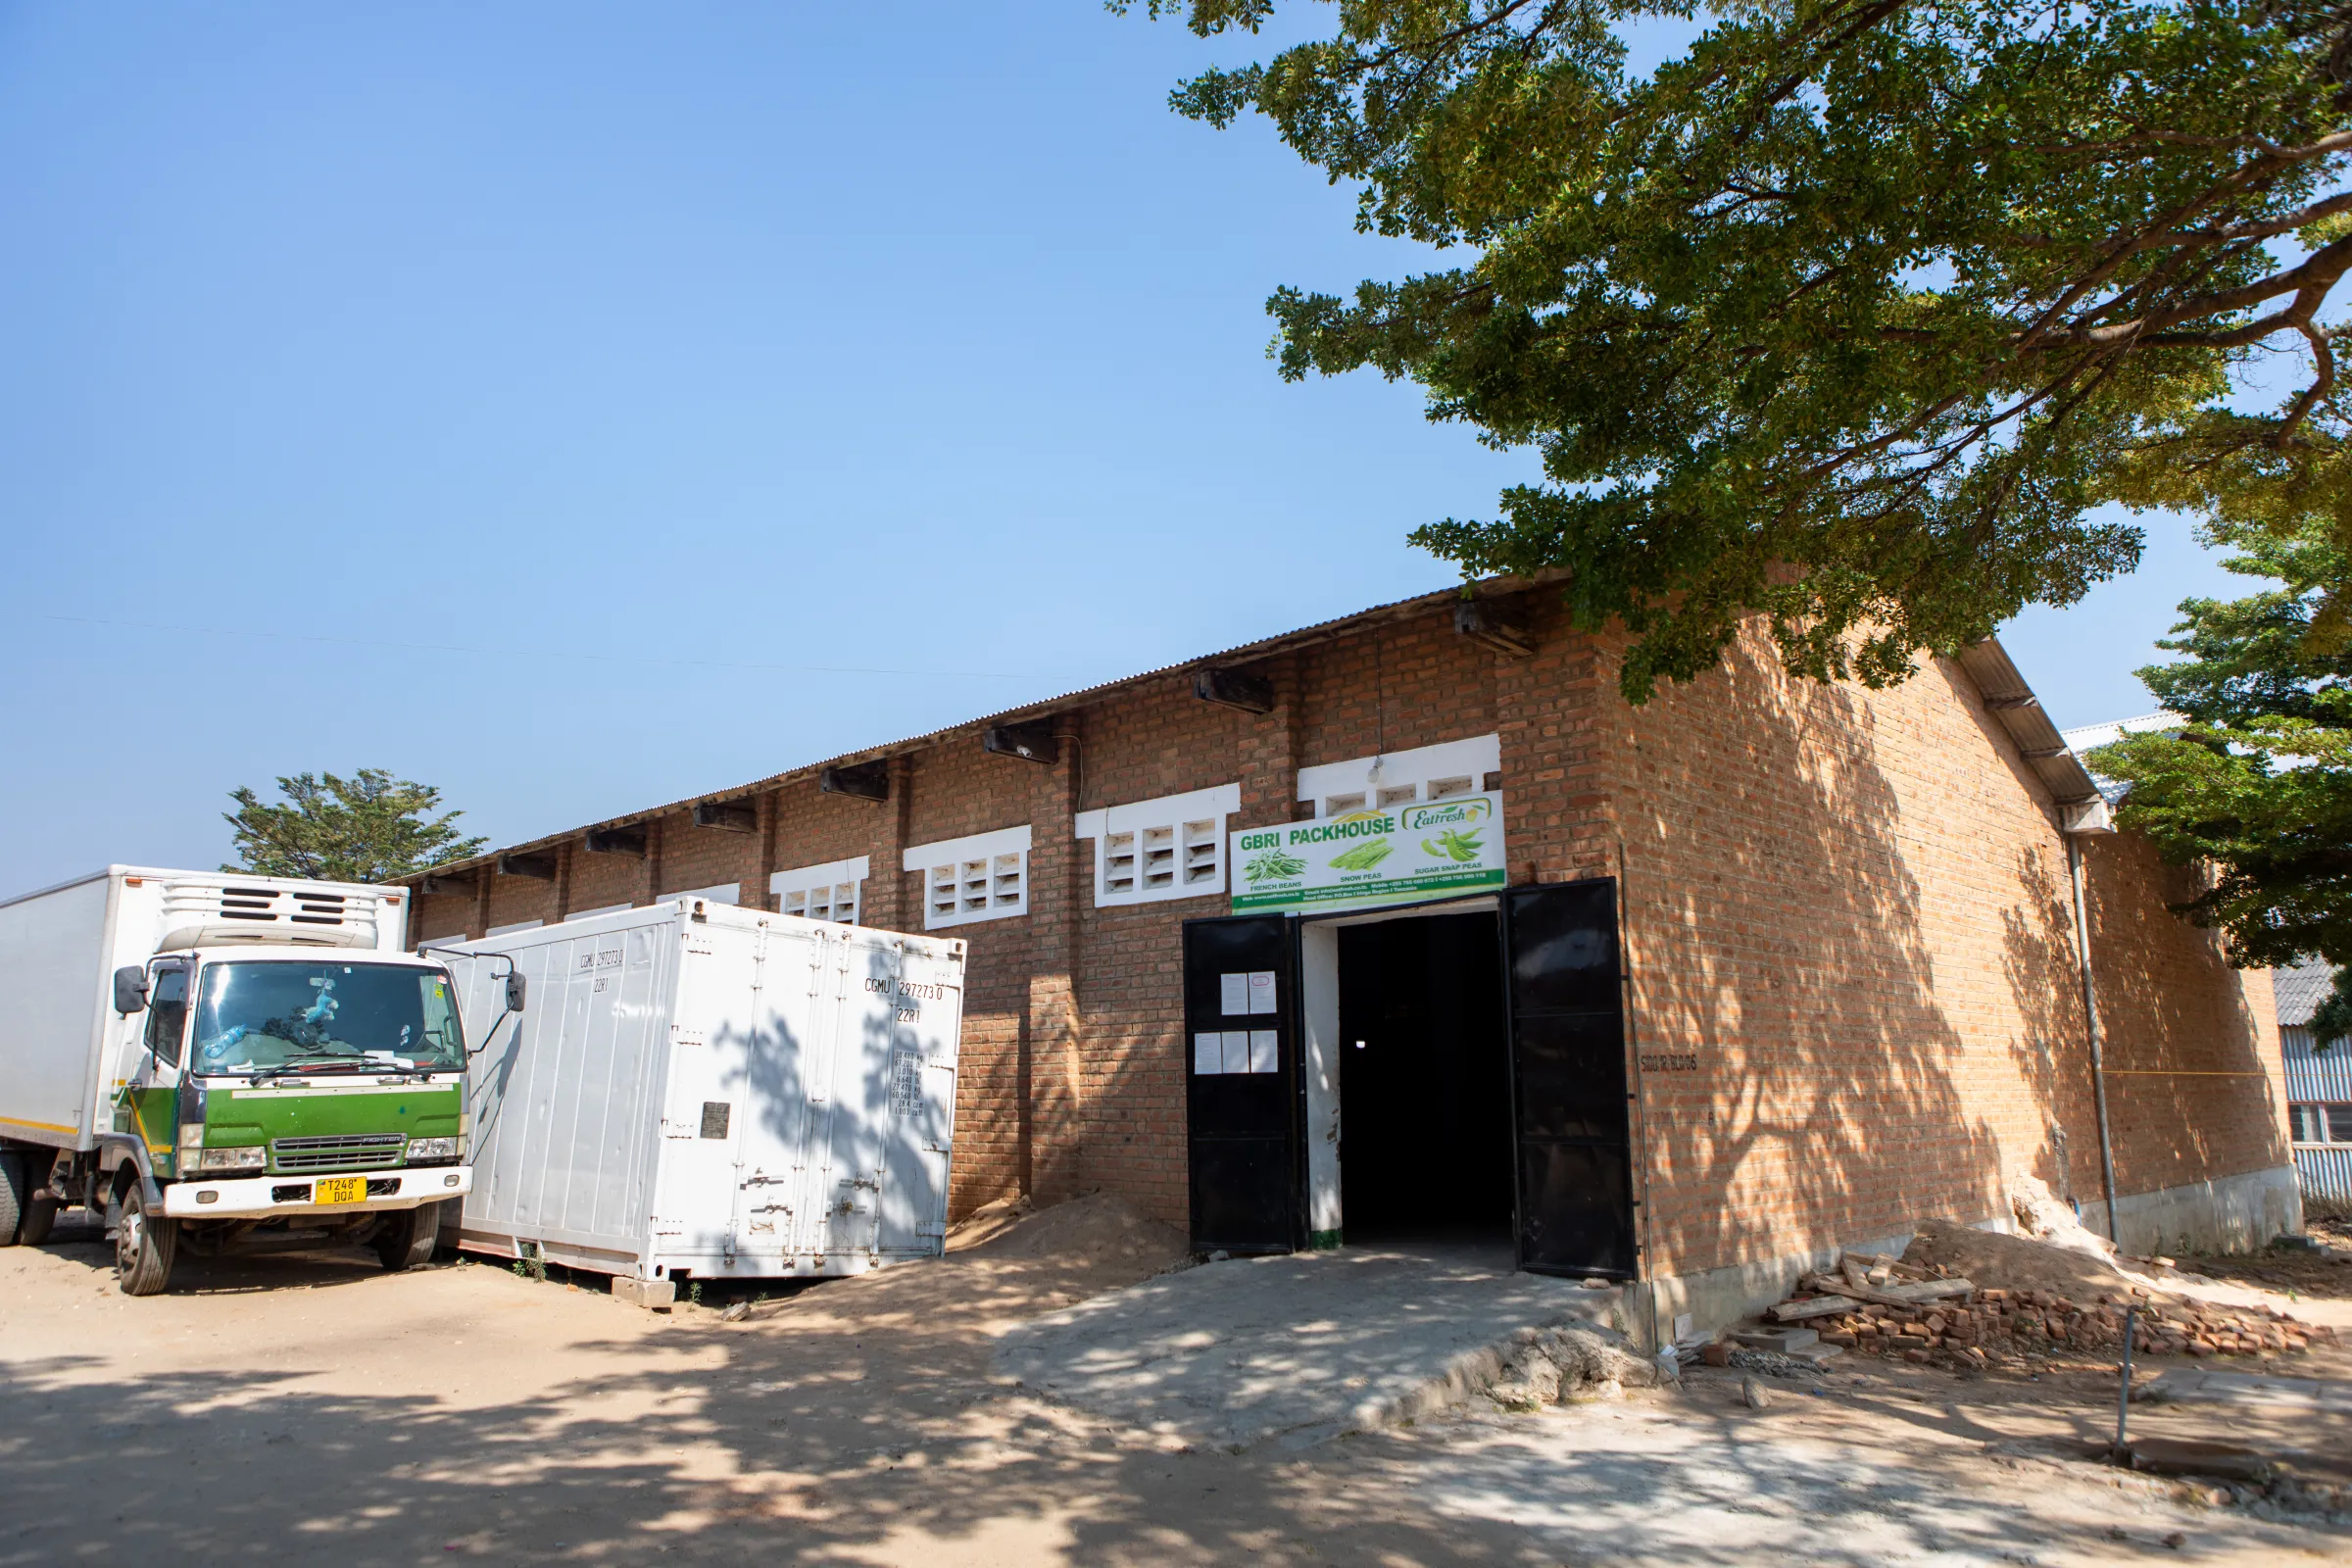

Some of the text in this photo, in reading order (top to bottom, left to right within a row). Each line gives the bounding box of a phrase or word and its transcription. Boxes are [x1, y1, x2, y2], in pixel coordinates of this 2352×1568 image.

[1414, 808, 1465, 829] Eatfresh
[1241, 817, 1395, 851] GBRI PACKHOUSE
[598, 950, 618, 965] 297273
[864, 978, 943, 1000] CGMU 297273 0
[327, 1179, 354, 1191] T248
[334, 1191, 354, 1202] DQA
